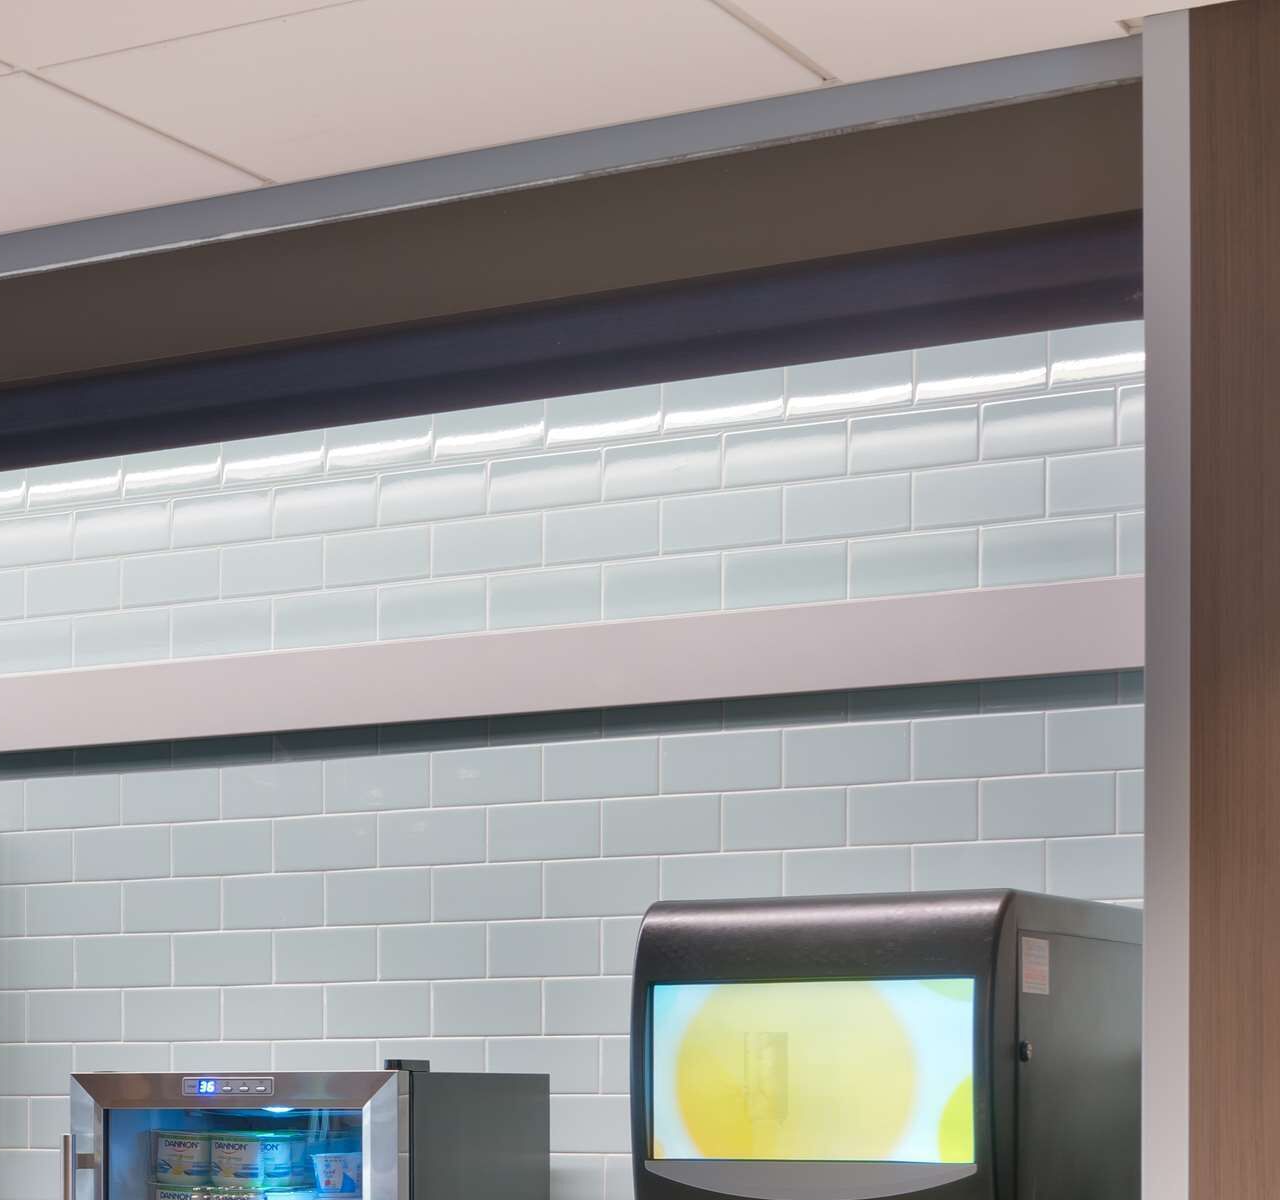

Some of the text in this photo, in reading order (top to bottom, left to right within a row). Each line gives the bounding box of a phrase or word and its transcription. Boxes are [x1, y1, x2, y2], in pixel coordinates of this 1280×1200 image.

[199, 1080, 215, 1093] 36
[164, 1140, 198, 1149] DANNON
[214, 1142, 247, 1151] DANNON
[160, 1191, 192, 1200] DANNON
